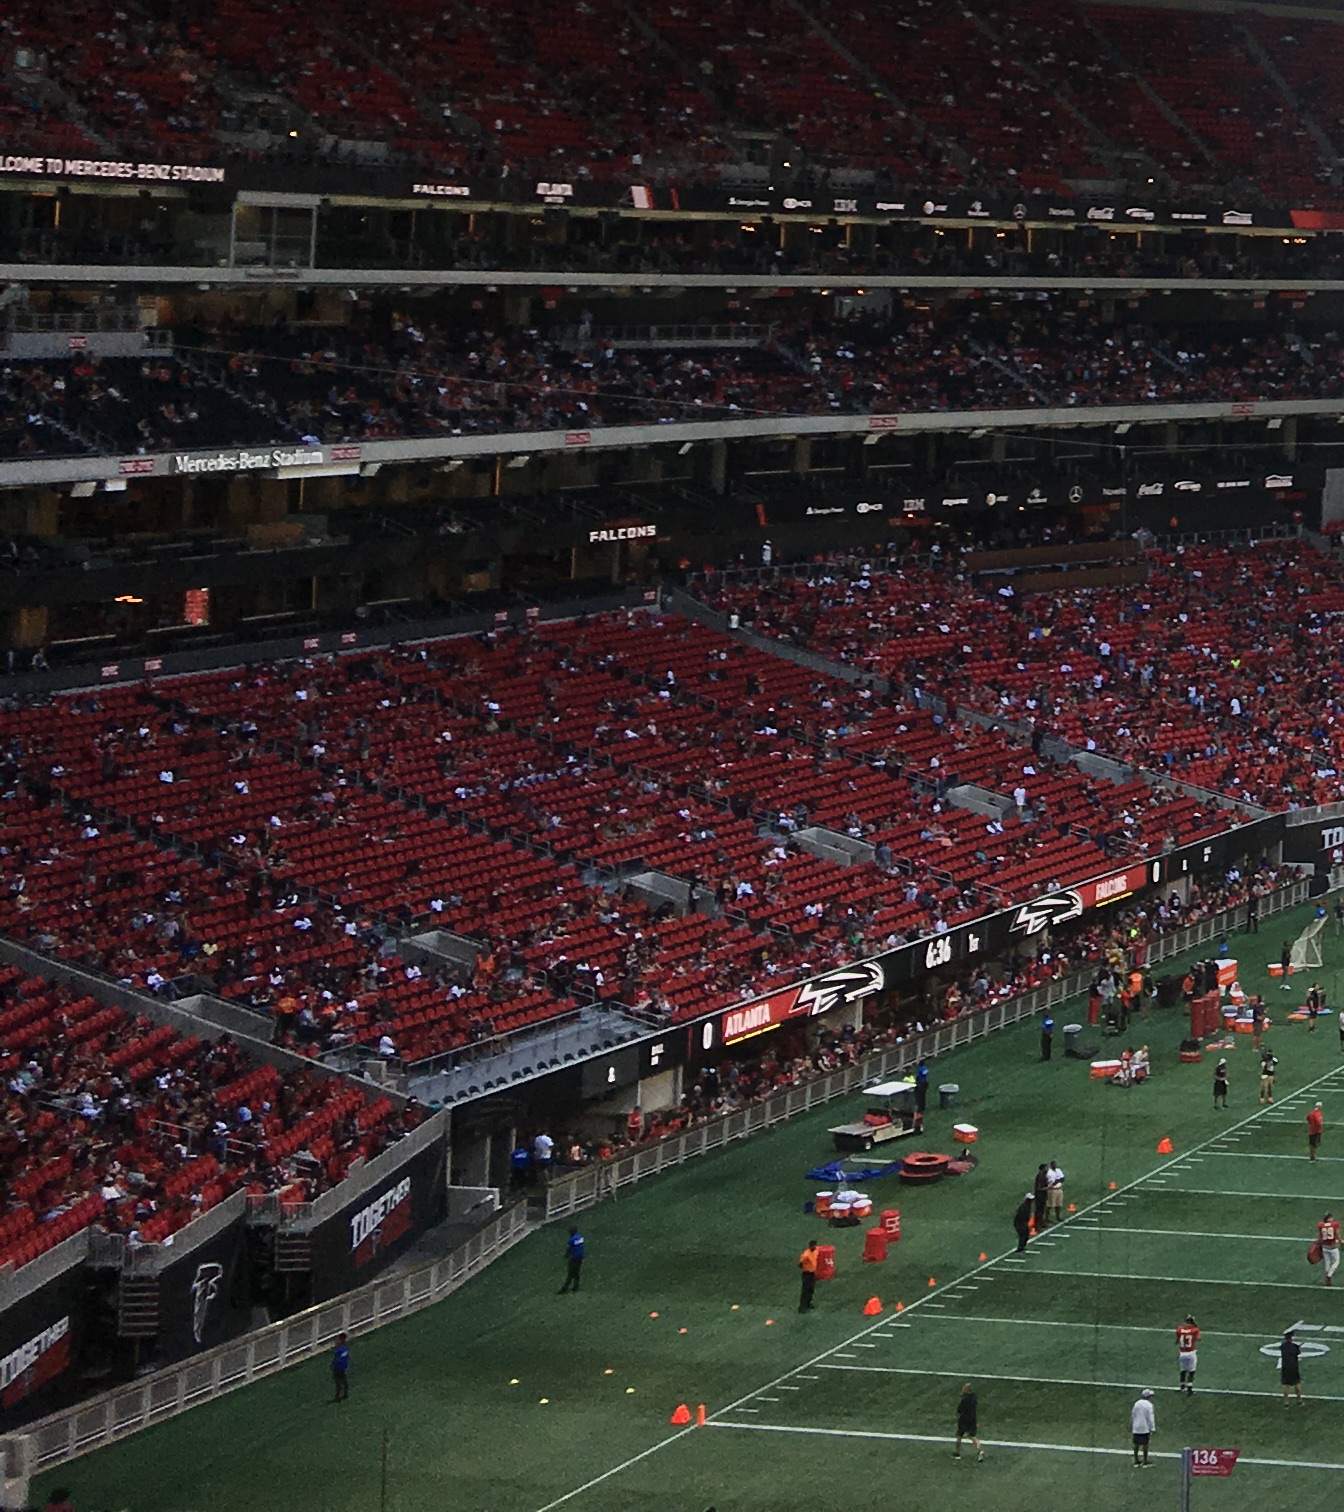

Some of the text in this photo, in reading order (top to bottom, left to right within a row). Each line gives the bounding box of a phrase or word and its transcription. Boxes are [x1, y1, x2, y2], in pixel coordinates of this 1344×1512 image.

[47, 158, 63, 174] TO
[65, 159, 172, 179] MERCEDES-BENZ
[172, 165, 225, 182] STADIUM
[175, 452, 270, 474] Mercedes-Benz
[272, 448, 323, 467] Stadium
[590, 524, 657, 543] FALCONS
[1095, 874, 1128, 901] FALCONS
[926, 935, 952, 969] 6:36
[725, 1003, 770, 1038] ATLANTA
[350, 1176, 411, 1251] TOGETHER
[1193, 1450, 1218, 1464] 136
